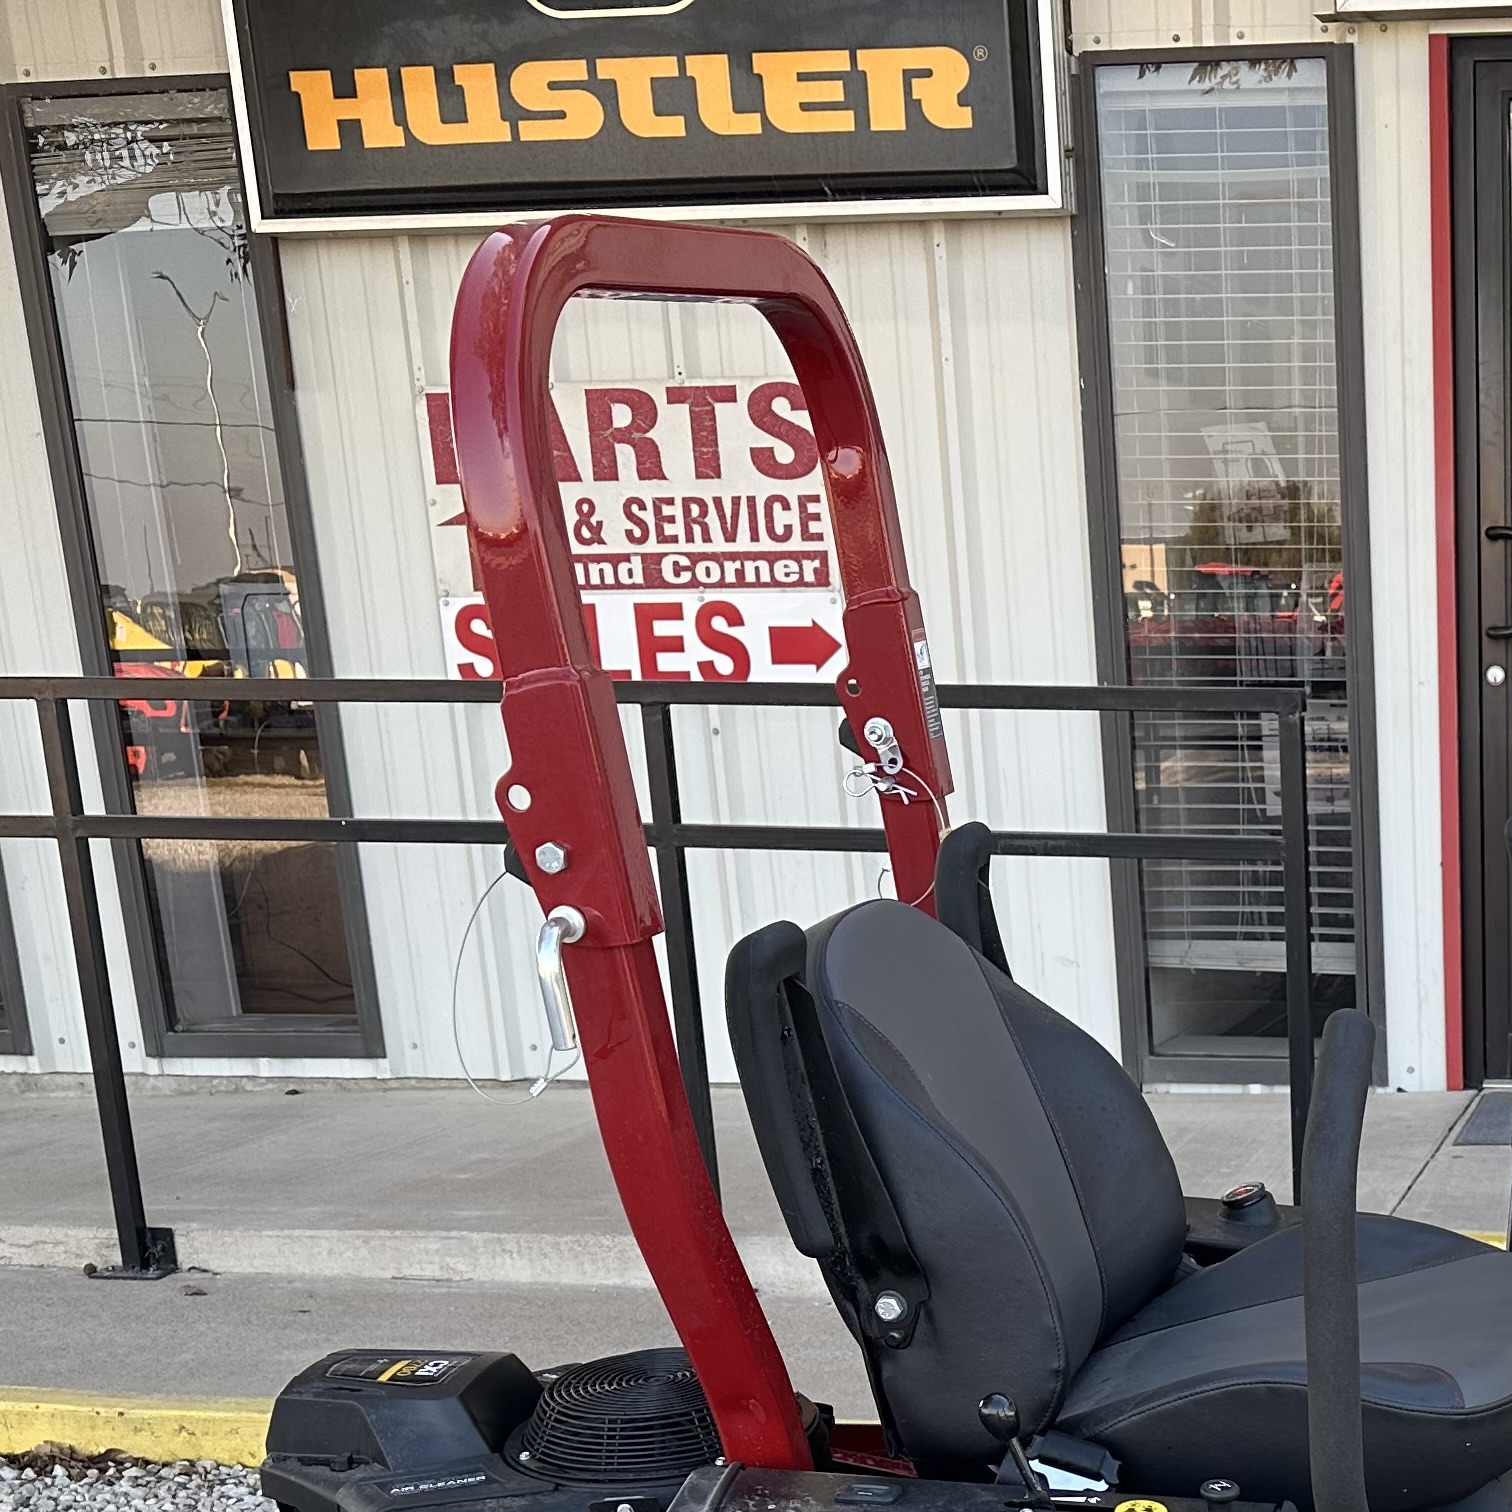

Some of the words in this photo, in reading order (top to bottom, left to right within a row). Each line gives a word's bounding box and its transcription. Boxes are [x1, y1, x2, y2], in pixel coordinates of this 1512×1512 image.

[290, 45, 972, 150] HUSTLER
[426, 381, 819, 485] RTS
[573, 496, 606, 545] &
[622, 494, 825, 545] SERVICE
[660, 553, 822, 585] Corner
[454, 600, 752, 682] SLES
[419, 1475, 487, 1491] CLEANER
